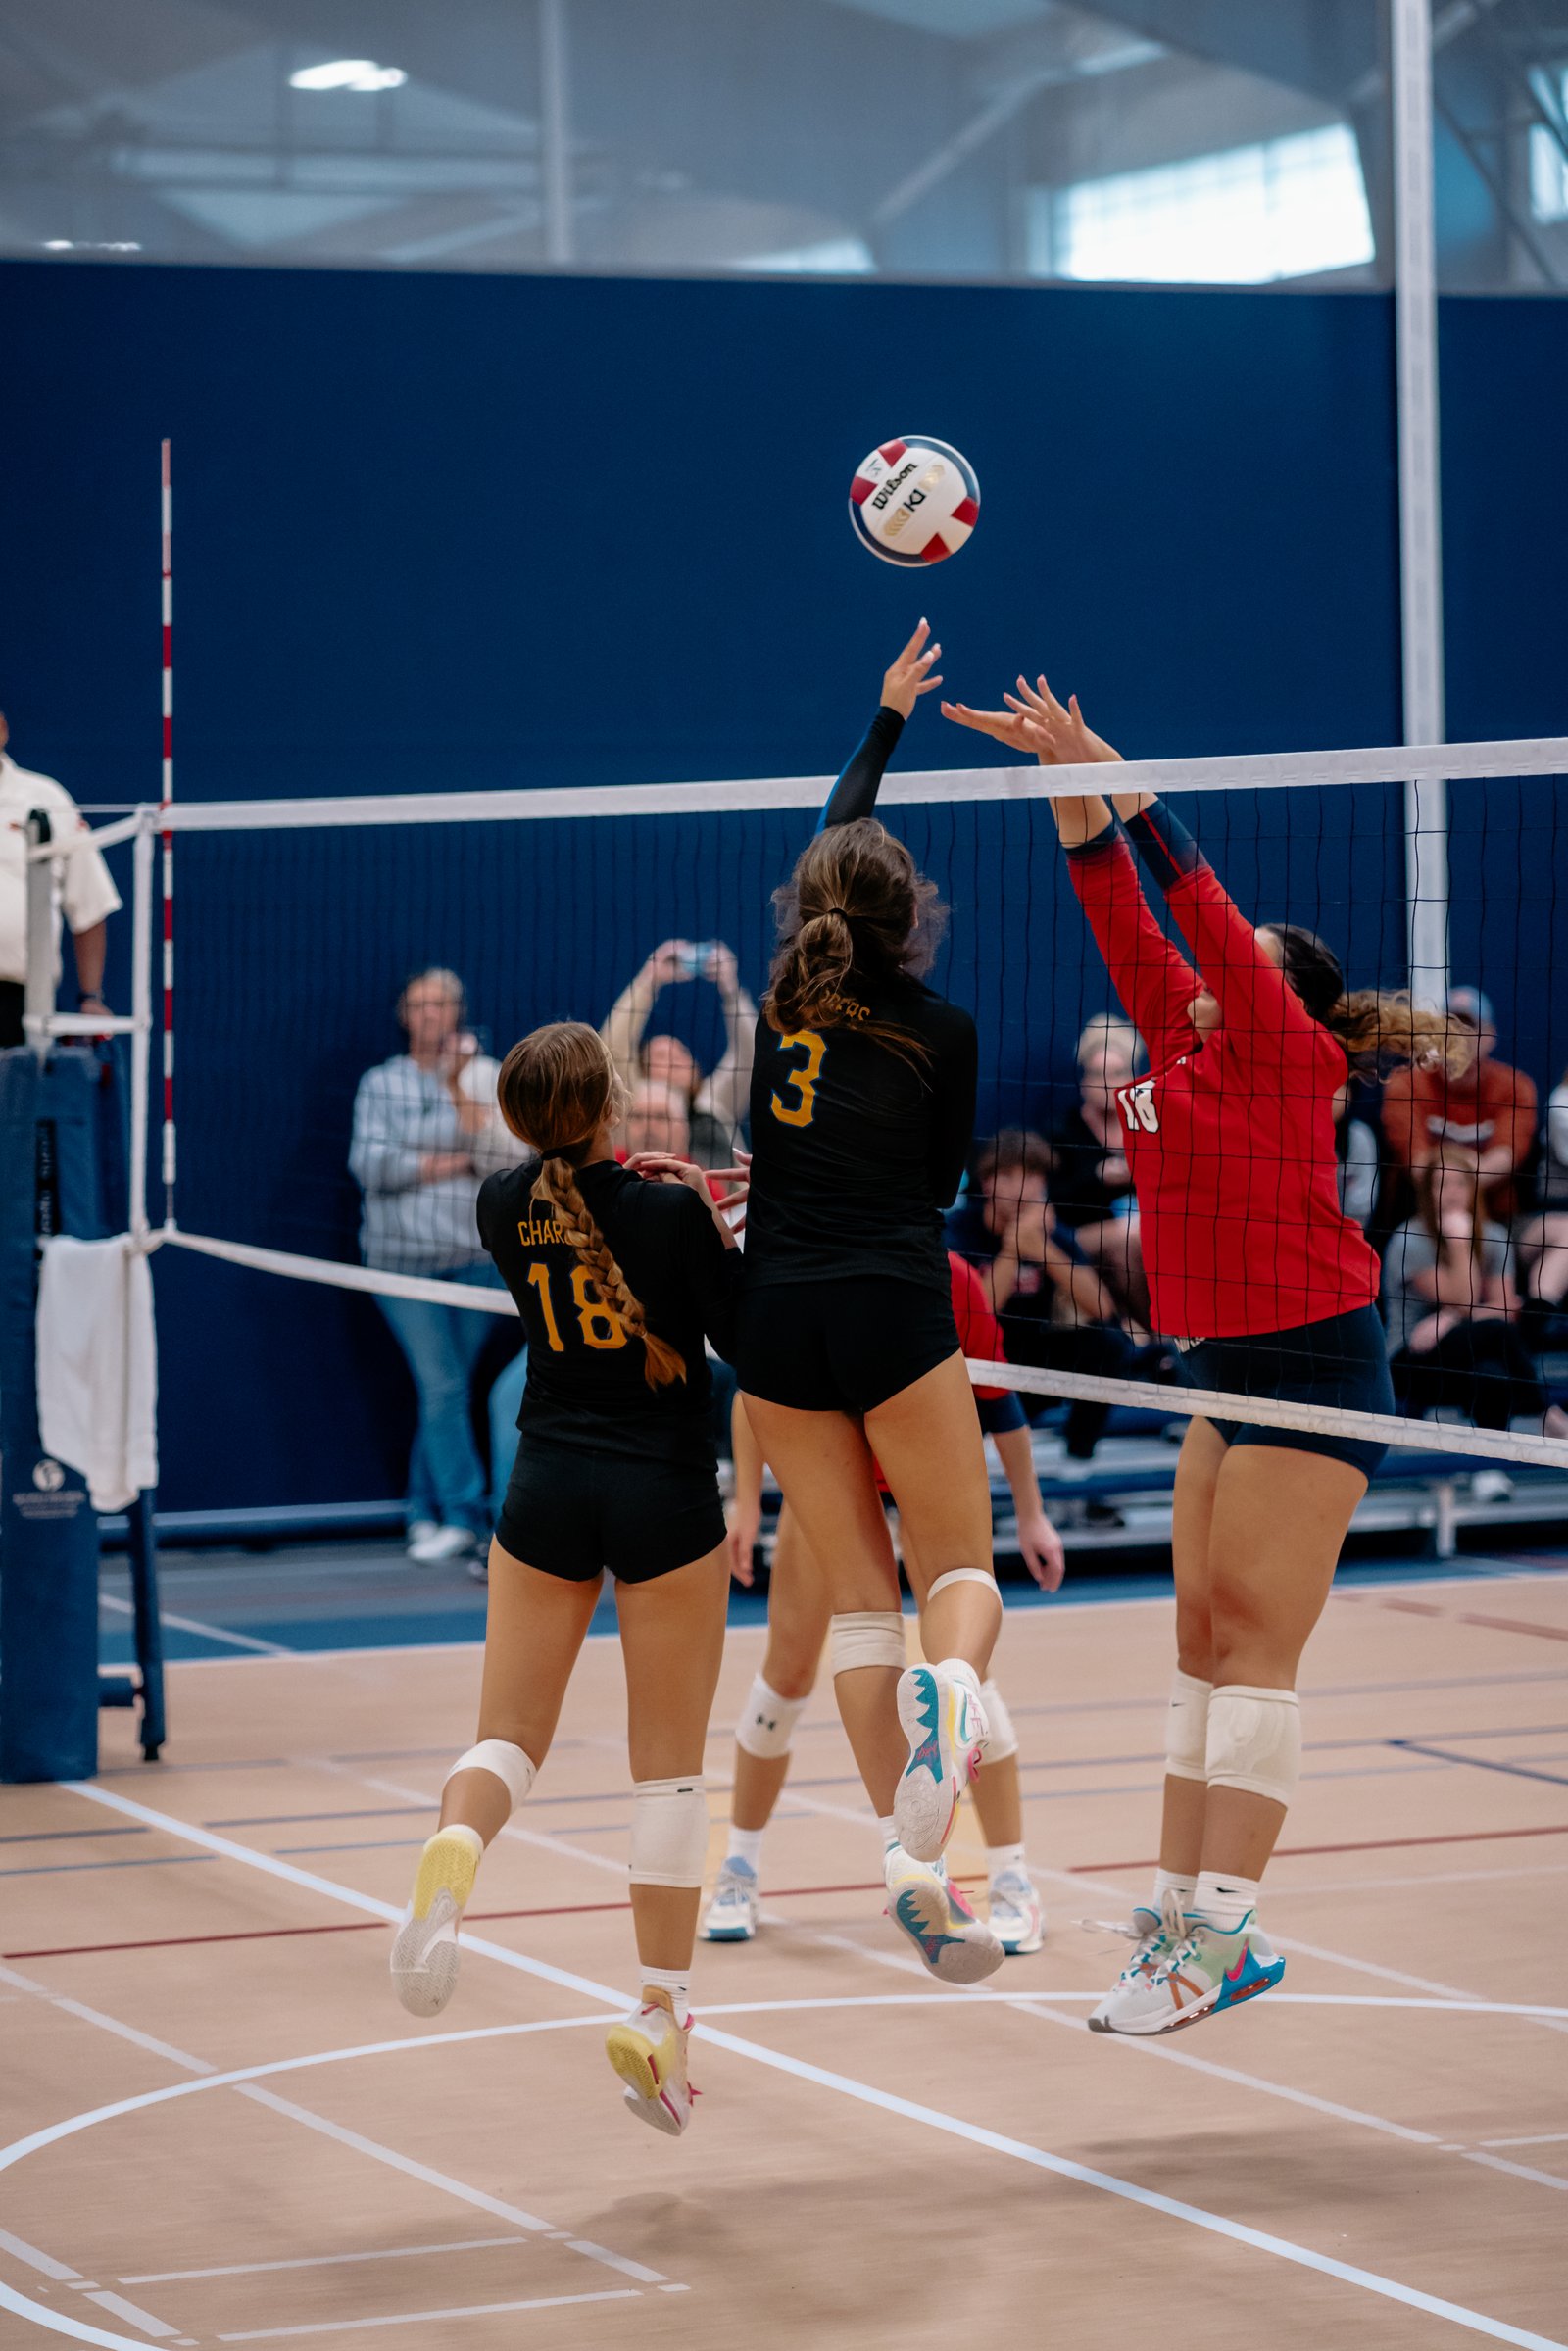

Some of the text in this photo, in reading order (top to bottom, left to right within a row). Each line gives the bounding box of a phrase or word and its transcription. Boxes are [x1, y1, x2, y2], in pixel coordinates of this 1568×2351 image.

[872, 463, 919, 511] Wilson
[770, 1029, 829, 1128] 3
[517, 1219, 565, 1247] CHAR
[527, 1262, 628, 1352] 18
